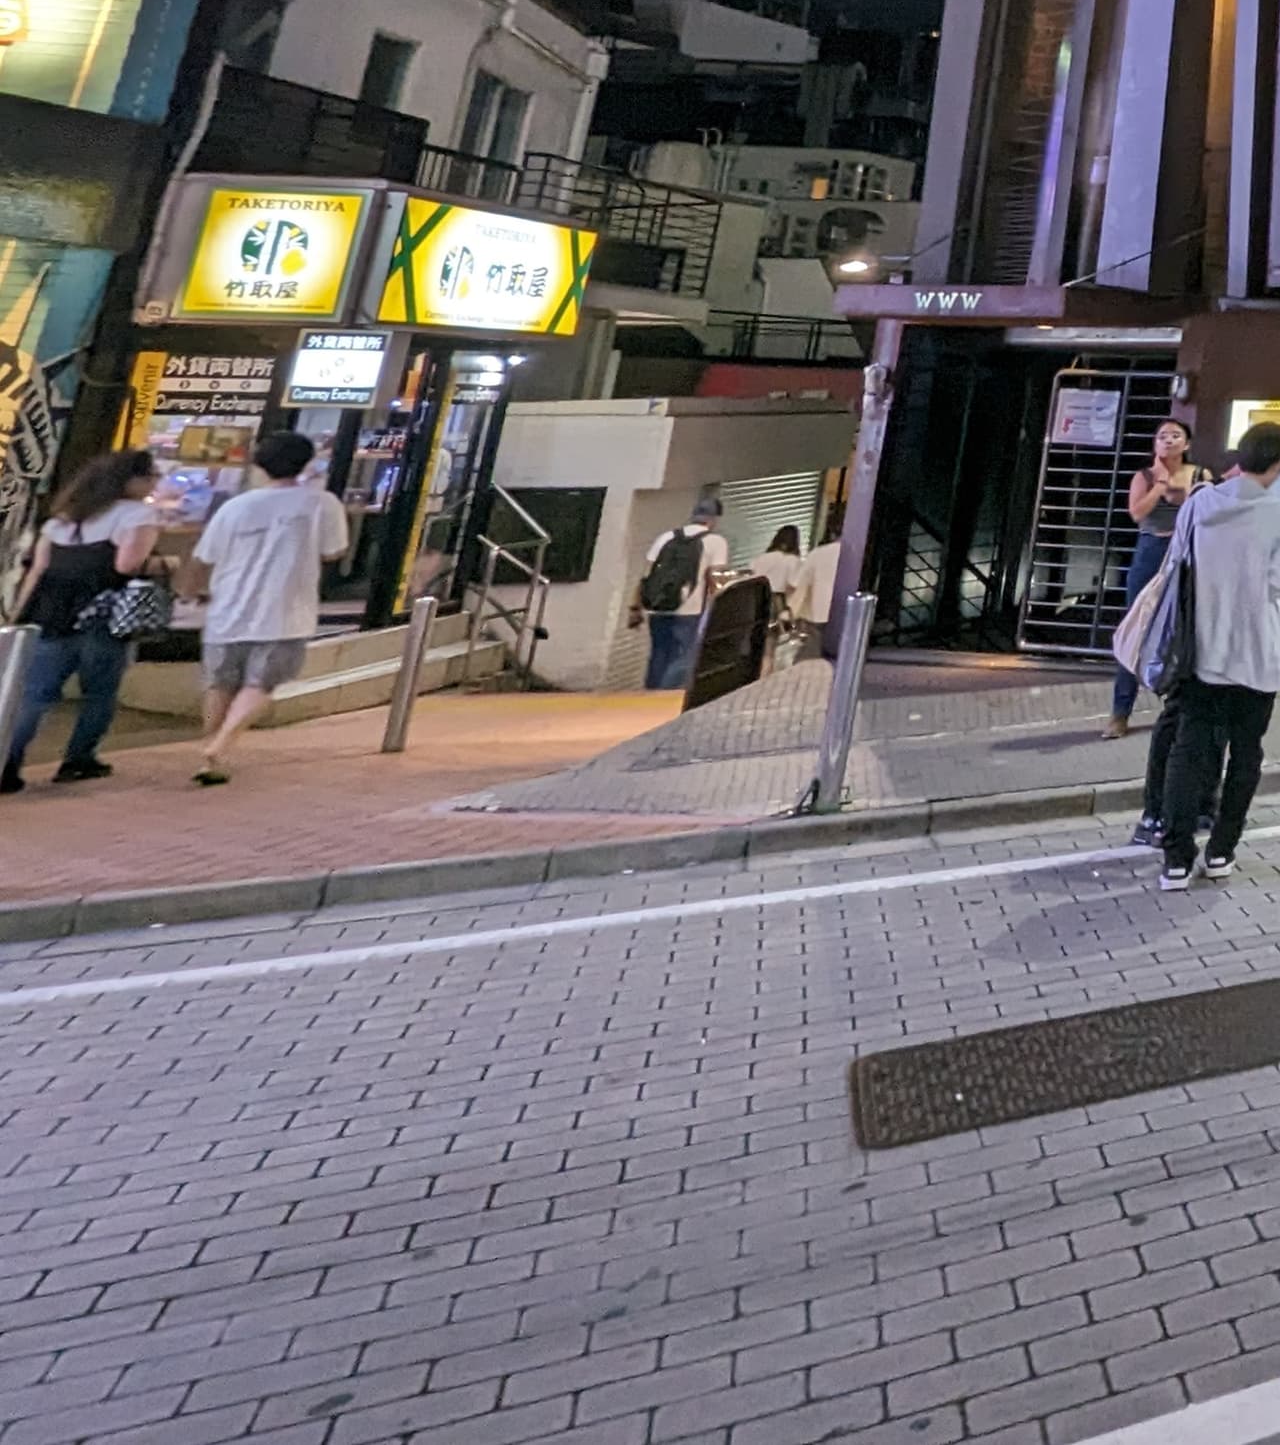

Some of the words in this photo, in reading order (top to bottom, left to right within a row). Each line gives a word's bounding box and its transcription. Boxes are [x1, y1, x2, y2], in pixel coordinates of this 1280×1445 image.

[228, 197, 347, 213] TAKETORIYA
[224, 279, 300, 299] 竹取屋
[486, 263, 548, 298] 竹取屋
[914, 291, 983, 310] WWW
[165, 355, 278, 377] 外貨両替所
[154, 394, 209, 412] Currency
[292, 387, 330, 402] Currency
